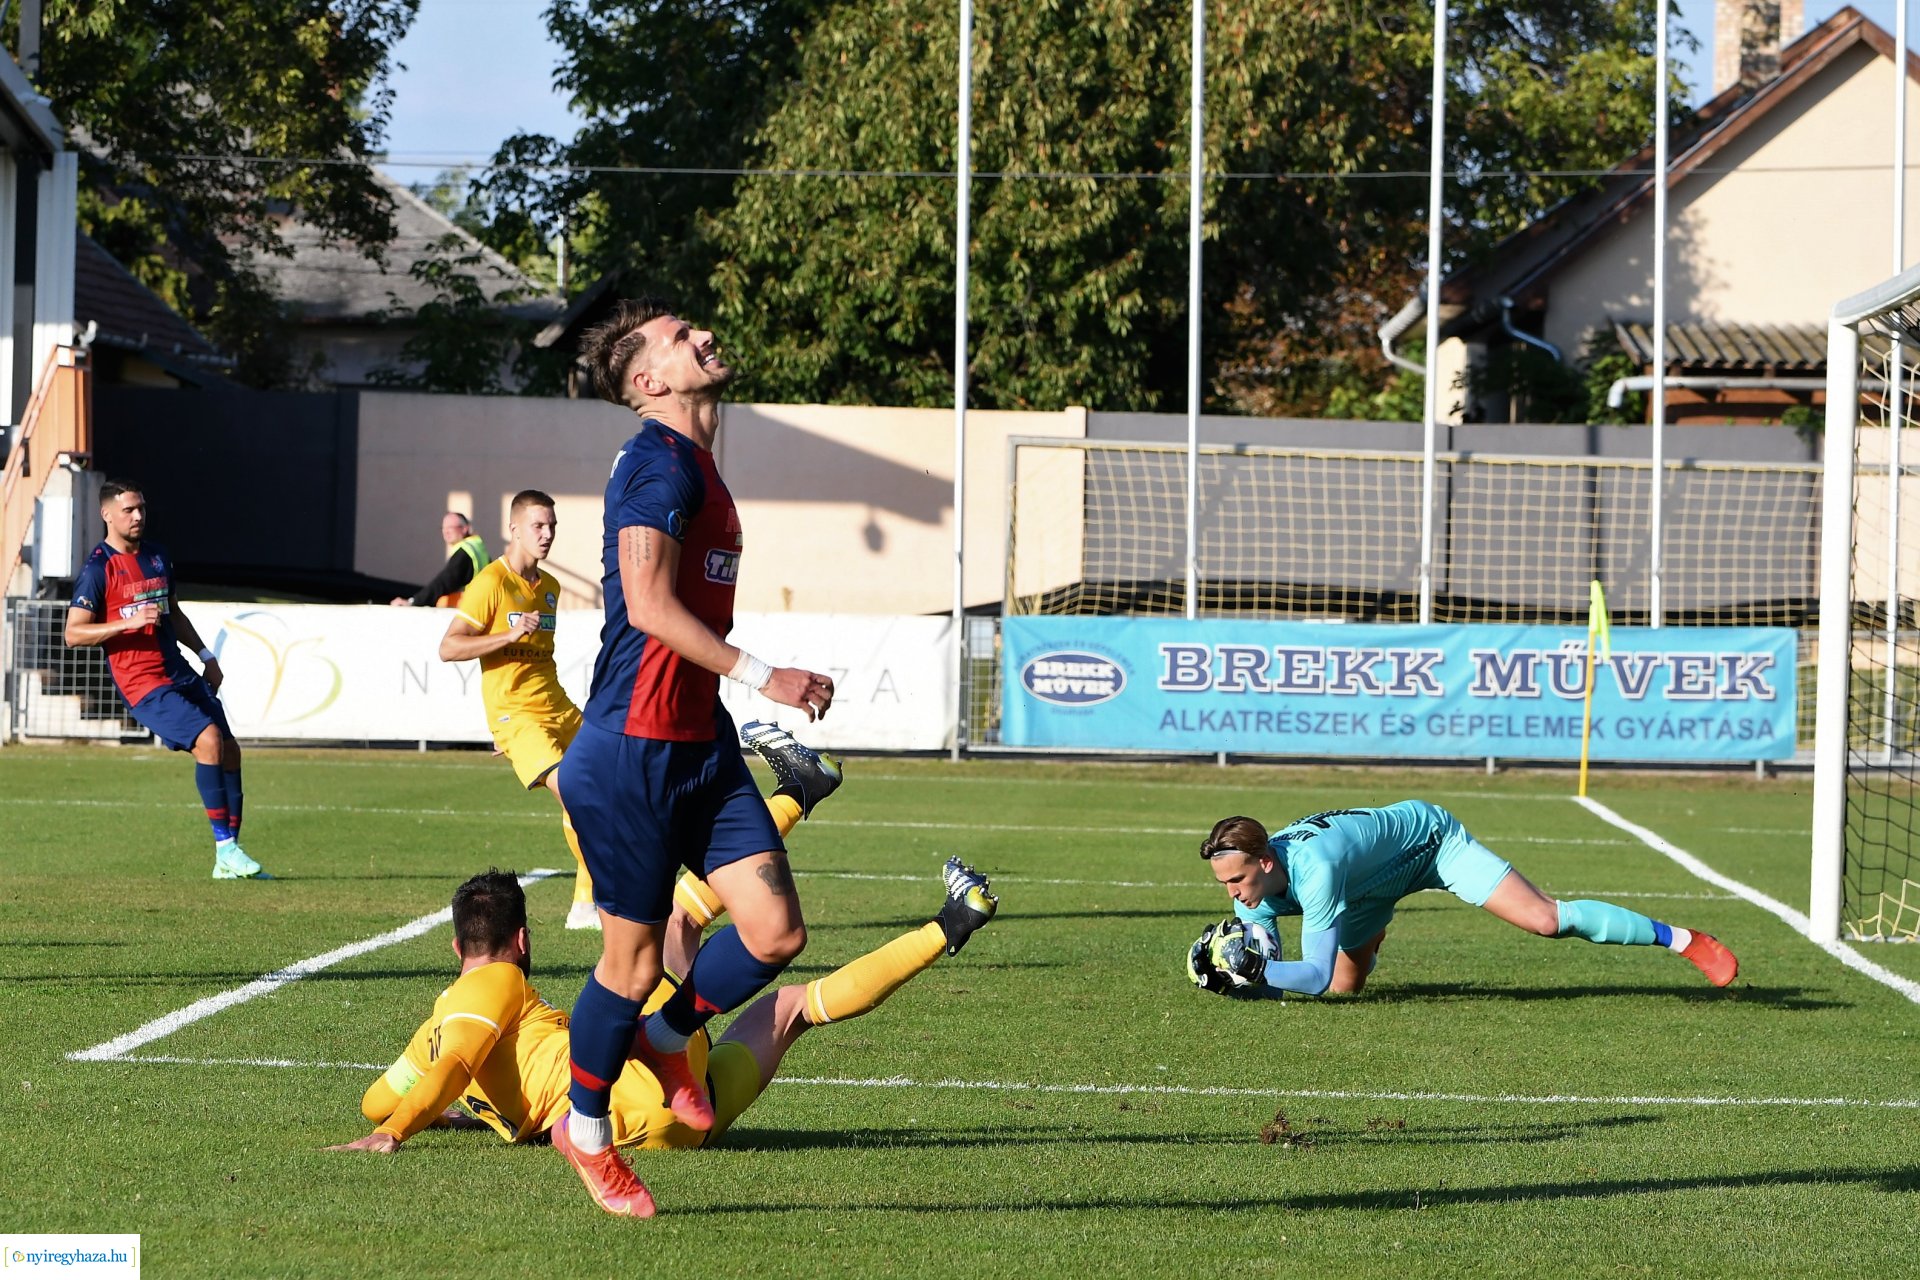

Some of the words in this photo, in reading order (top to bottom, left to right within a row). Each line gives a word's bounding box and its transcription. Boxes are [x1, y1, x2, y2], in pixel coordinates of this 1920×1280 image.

[1033, 661, 1115, 679] BREKK
[1158, 643, 1444, 696] BREKK
[1468, 639, 1776, 700] MŰVEK
[1159, 705, 1369, 735] ALKATRÉSZEK
[1380, 706, 1416, 736] ÉS
[1426, 709, 1604, 740] GÉPELEMEK
[1615, 711, 1776, 741] GYÁRTÁSA
